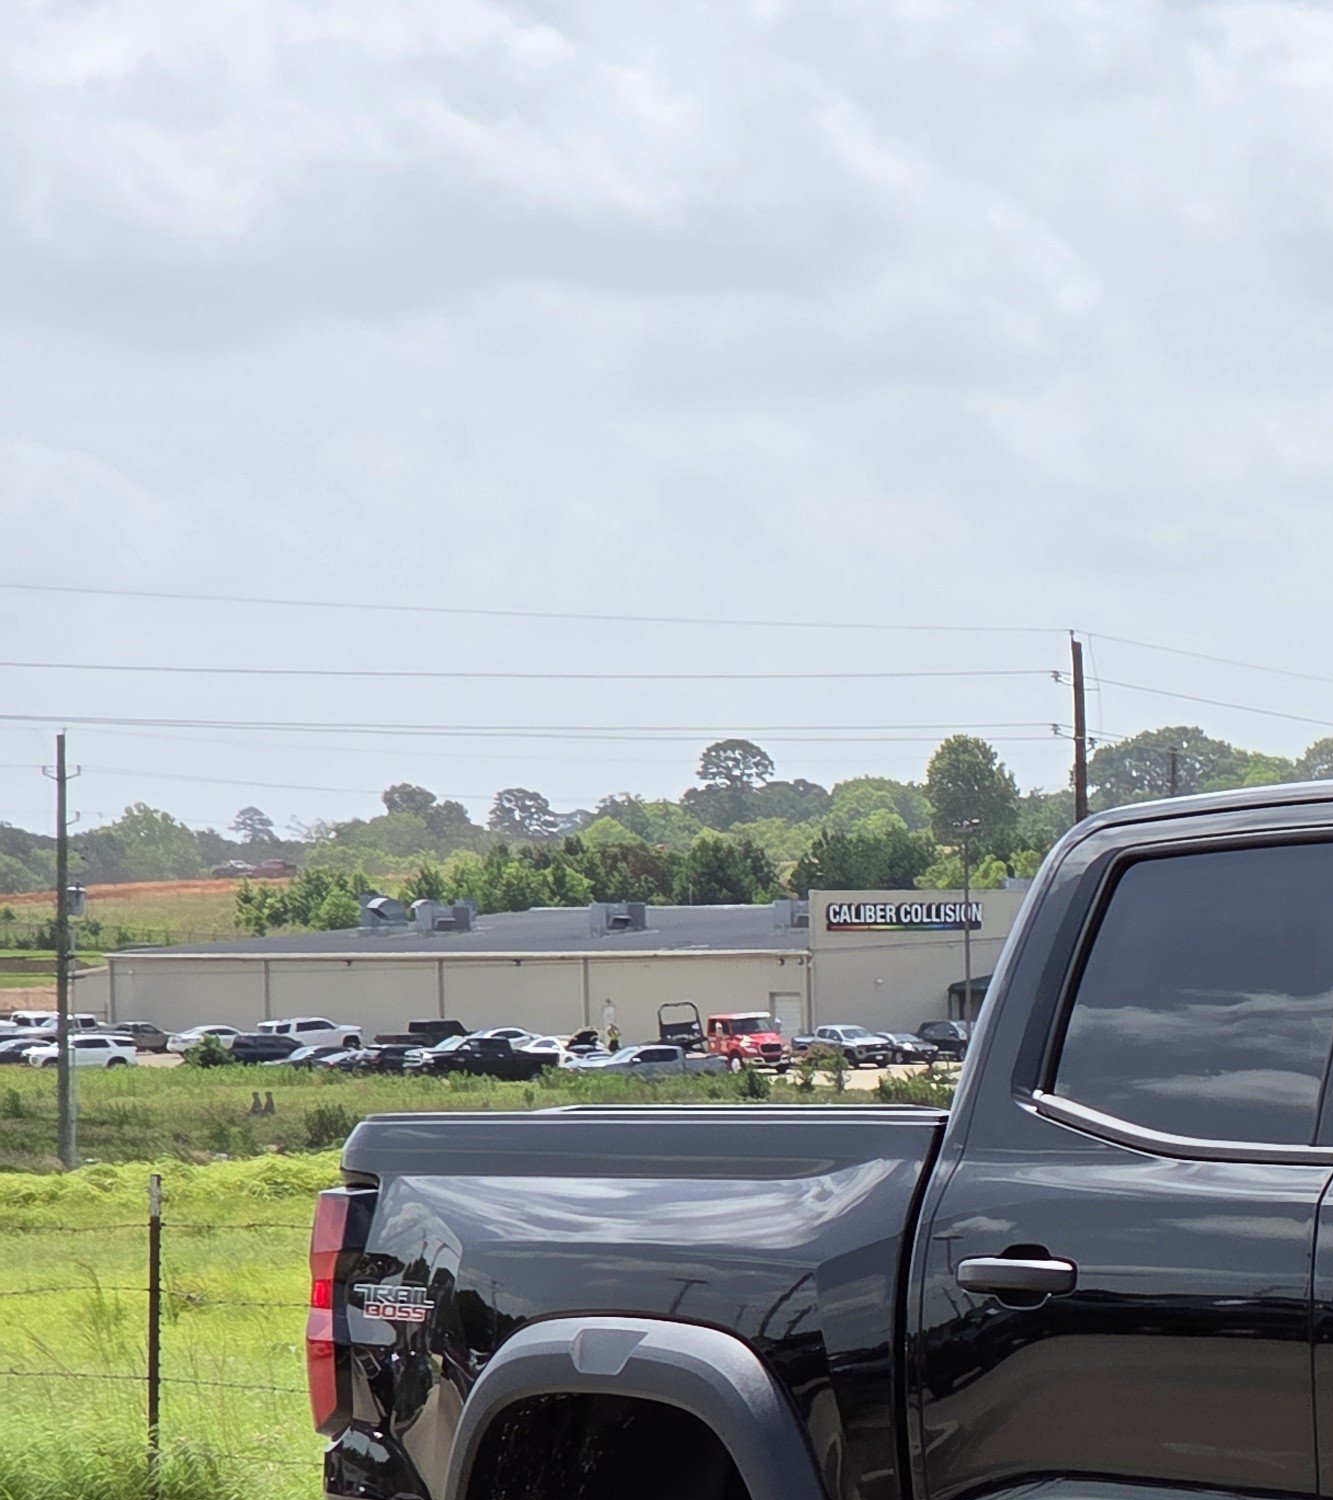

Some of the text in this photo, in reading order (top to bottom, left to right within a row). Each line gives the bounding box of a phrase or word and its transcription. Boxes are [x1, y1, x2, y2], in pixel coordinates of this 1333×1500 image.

[828, 902, 982, 924] CALIBER COLLISION
[354, 1284, 434, 1308] TRAIL
[363, 1303, 428, 1322] BOSS
